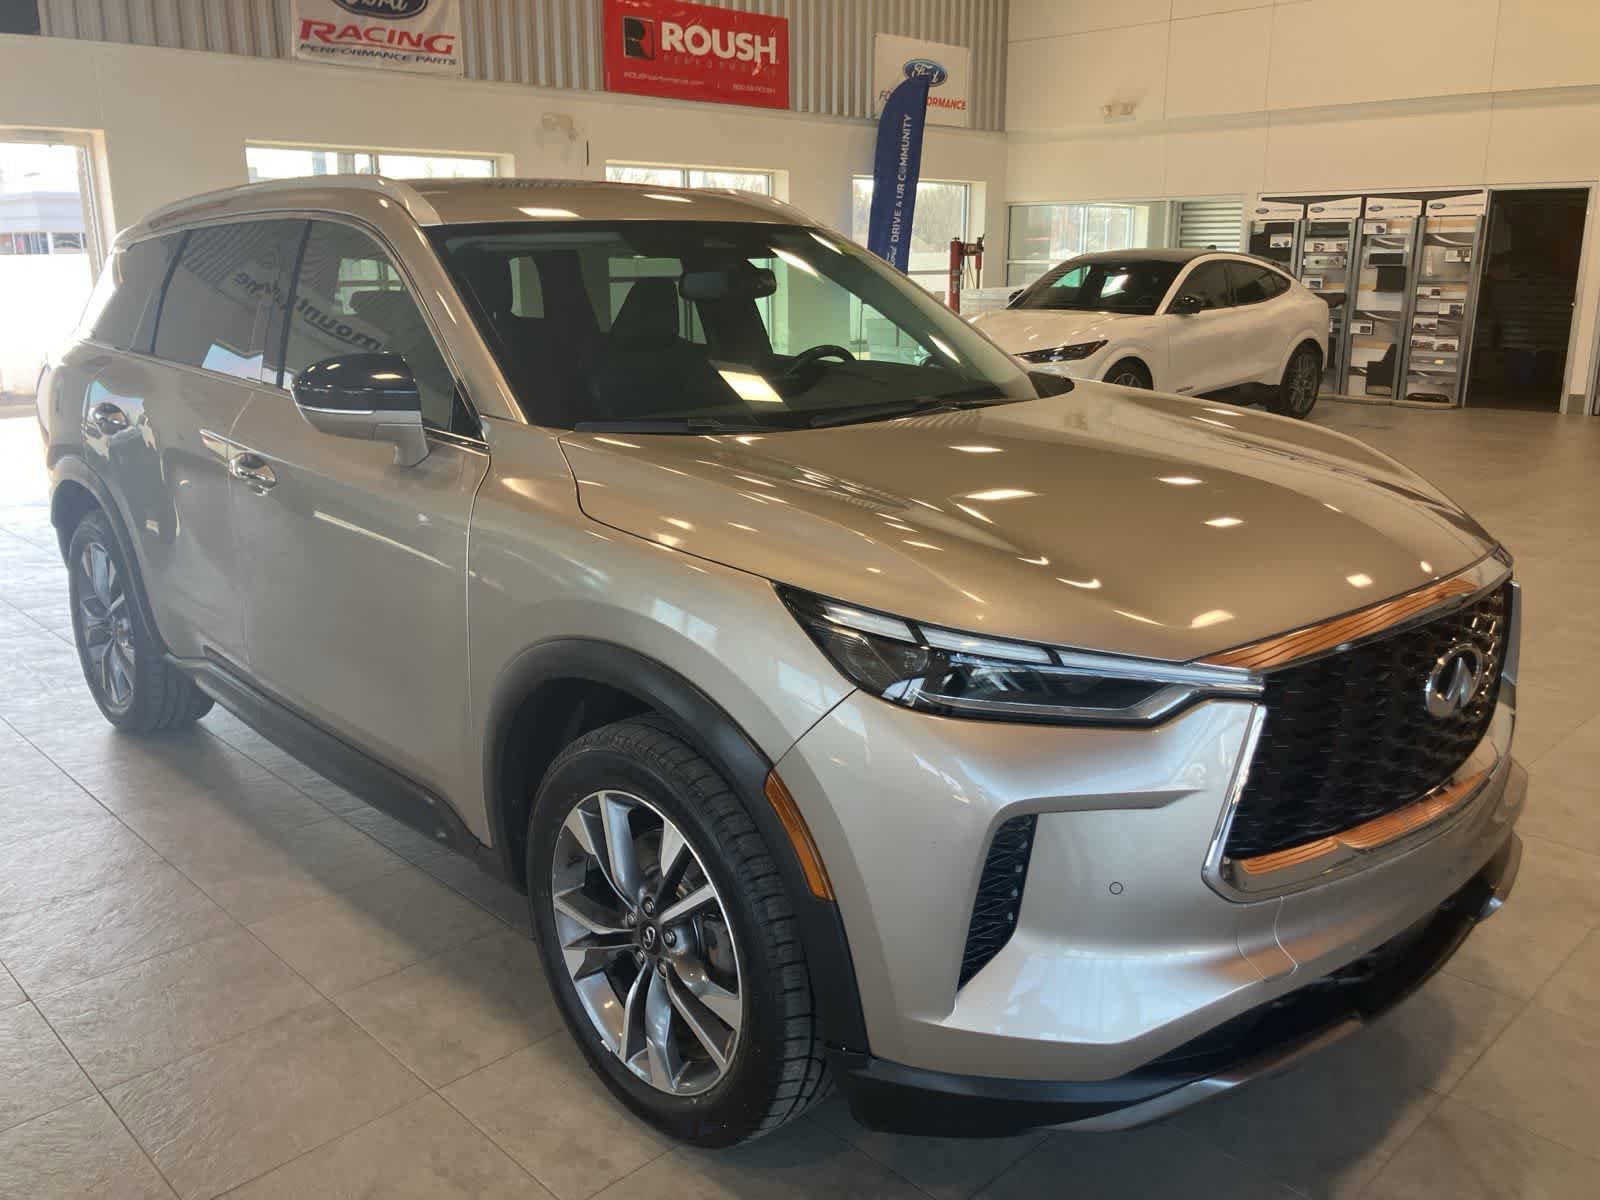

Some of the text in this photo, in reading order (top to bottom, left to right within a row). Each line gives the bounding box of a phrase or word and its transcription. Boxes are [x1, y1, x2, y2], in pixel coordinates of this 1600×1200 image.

[300, 19, 456, 55] RACING
[661, 21, 777, 64] ROUSH
[300, 43, 456, 66] PERFORMANCE PARTS
[899, 113, 913, 181] COMMUNITY
[896, 181, 905, 200] UR
[890, 209, 902, 242] DRIVE
